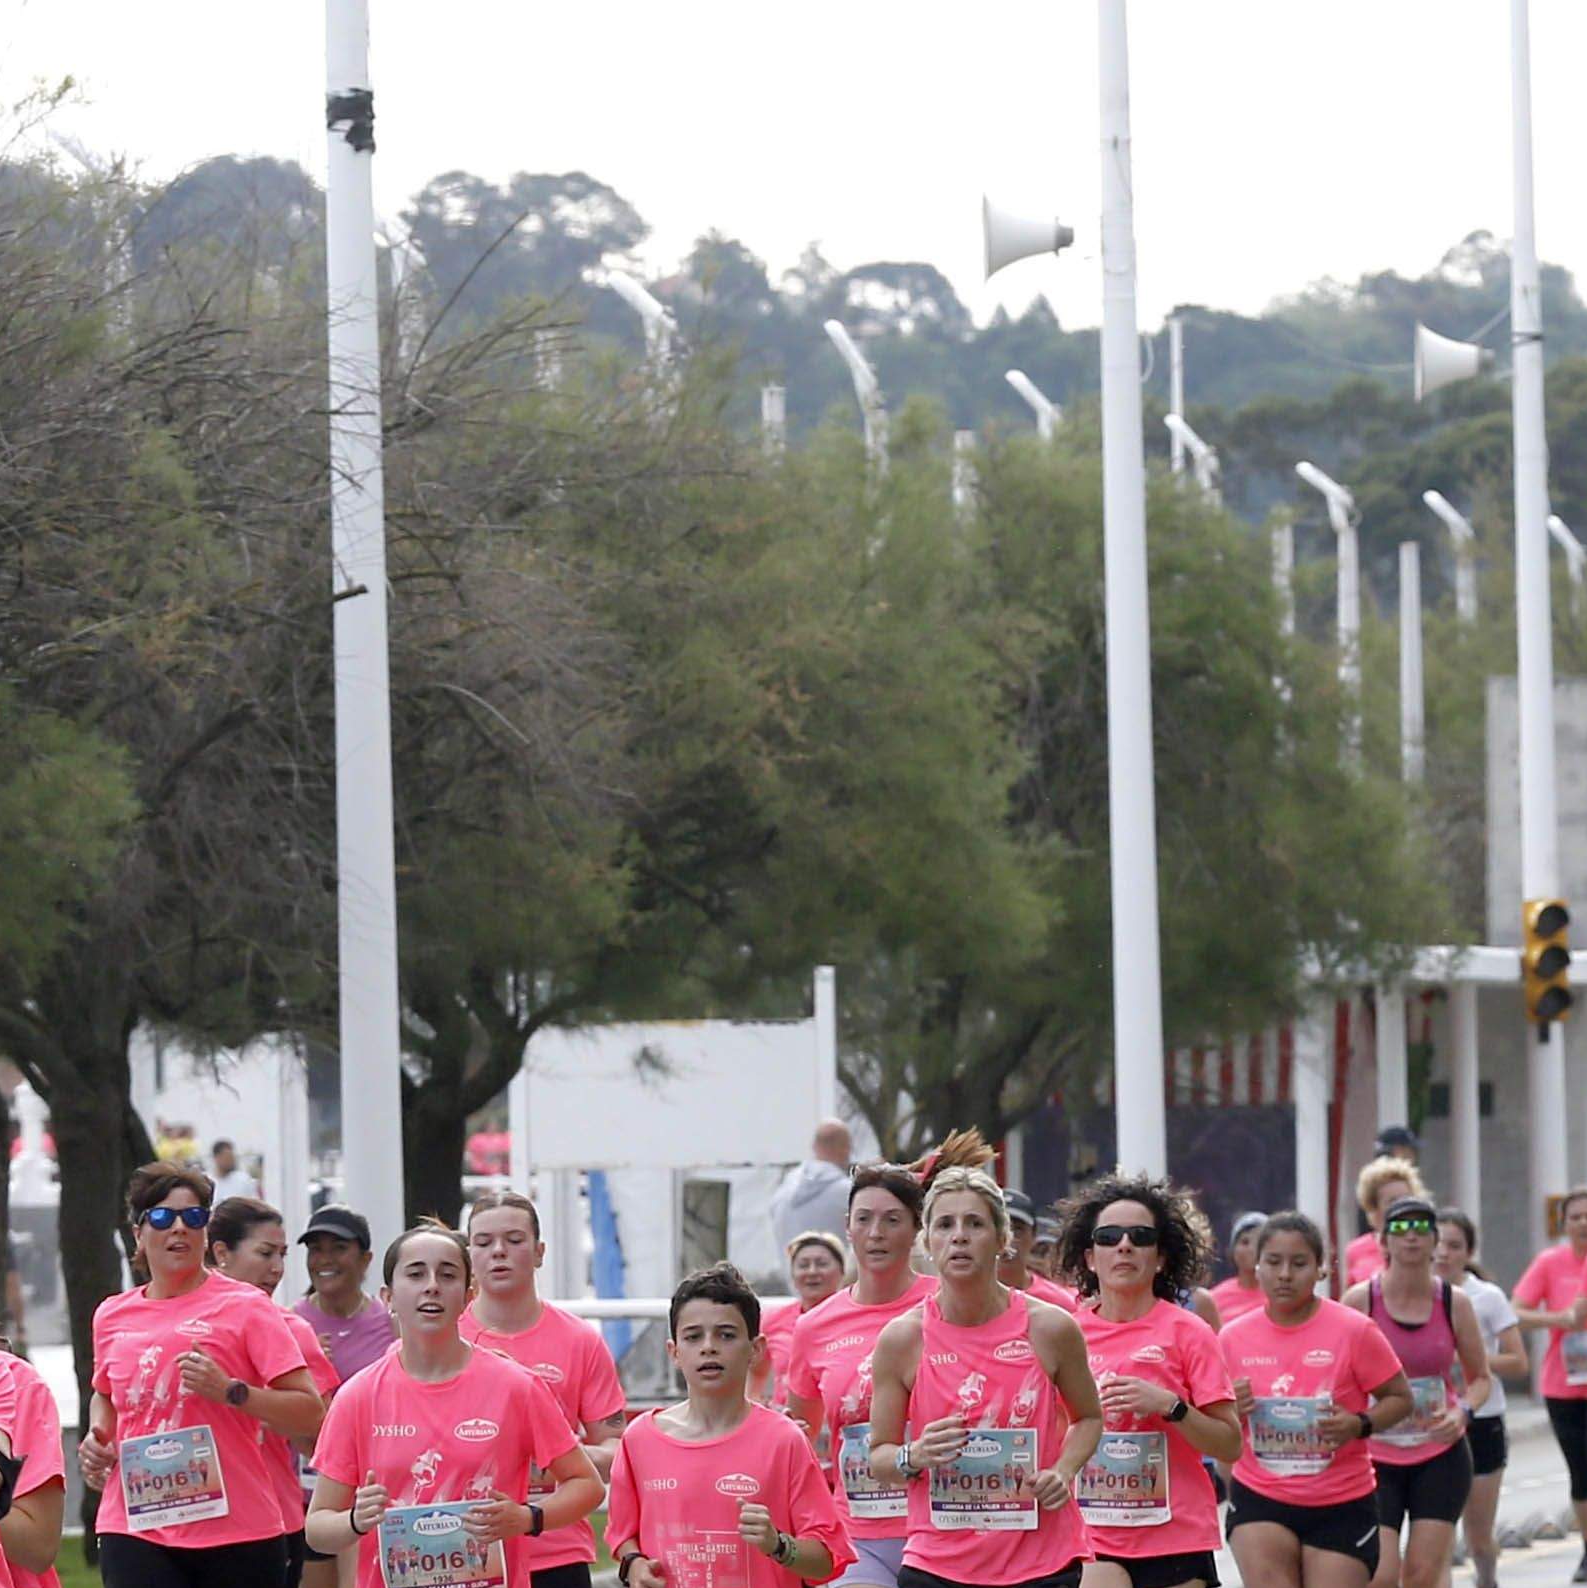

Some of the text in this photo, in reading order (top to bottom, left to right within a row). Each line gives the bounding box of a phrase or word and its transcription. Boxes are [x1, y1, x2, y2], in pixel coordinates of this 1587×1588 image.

[153, 1471, 188, 1490] 016
[719, 1481, 757, 1492] ASTURIANA
[960, 1473, 1001, 1490] 016
[1106, 1473, 1139, 1489] 016
[416, 1520, 459, 1532] ASTURIANA
[421, 1551, 465, 1572] 016
